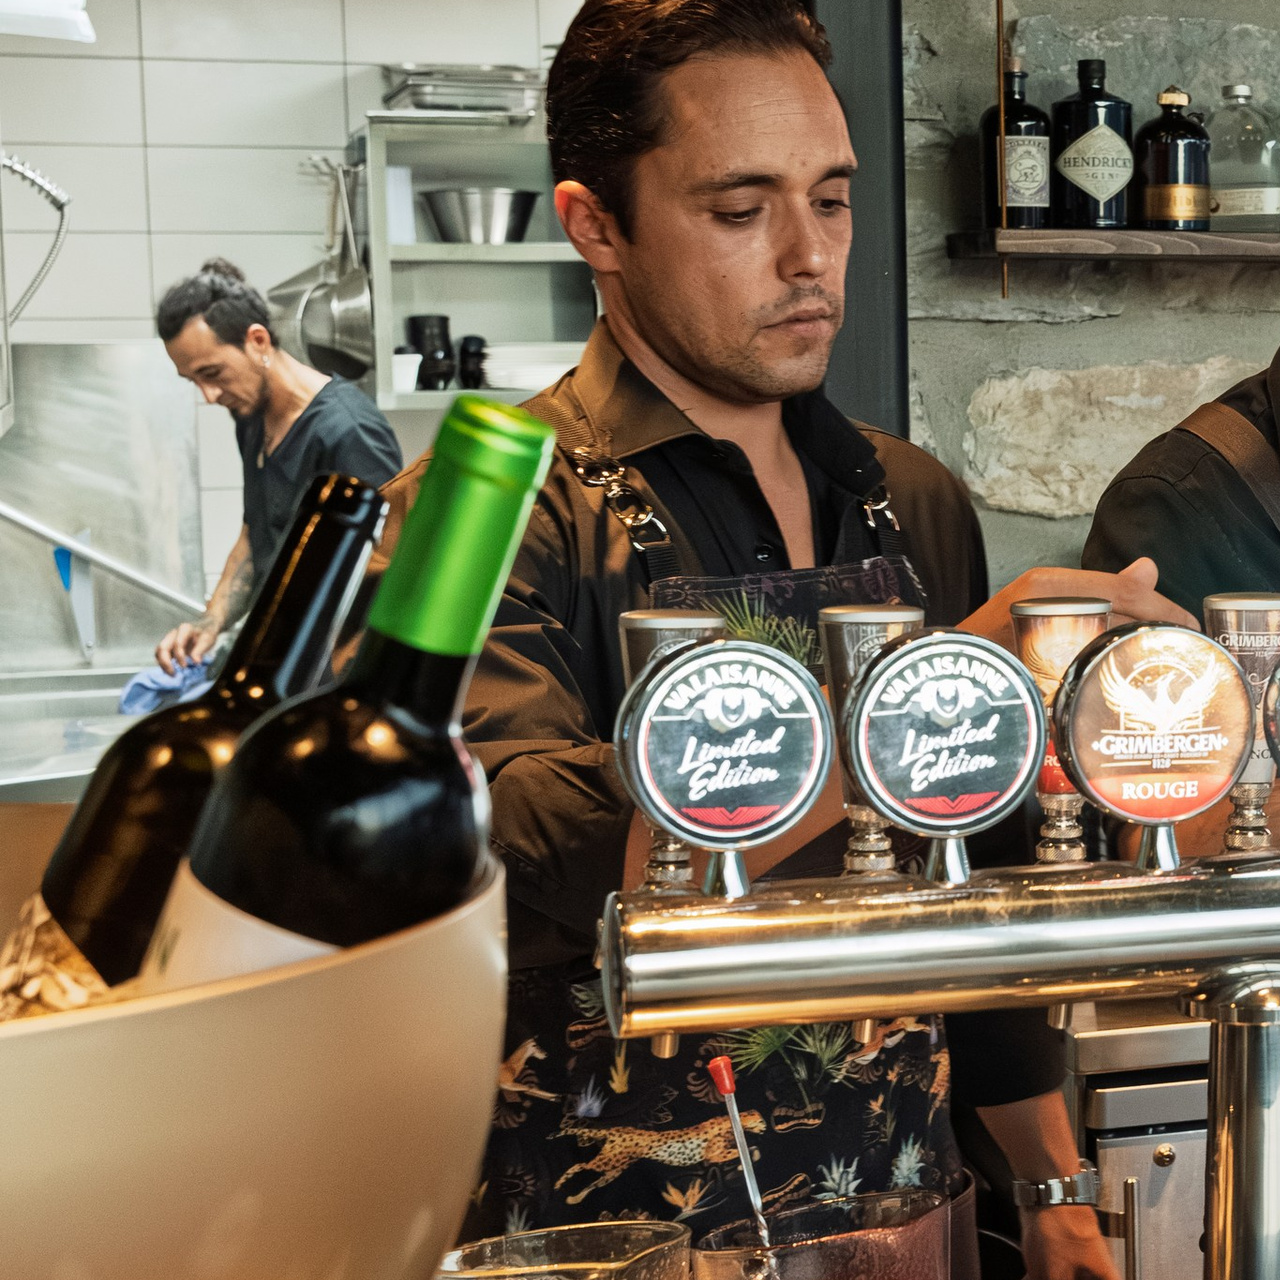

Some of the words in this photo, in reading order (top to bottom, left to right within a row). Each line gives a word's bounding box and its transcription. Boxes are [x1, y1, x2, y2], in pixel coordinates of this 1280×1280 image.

[663, 663, 799, 711] VALAISANNE
[880, 655, 1010, 704] VALAISANNE
[676, 725, 787, 775] Limited
[898, 713, 1001, 767] Limited
[1099, 733, 1223, 756] GRIMBERGEN
[688, 759, 781, 802] Edition
[910, 748, 998, 793] Edition
[1121, 780, 1199, 800] ROUGE
